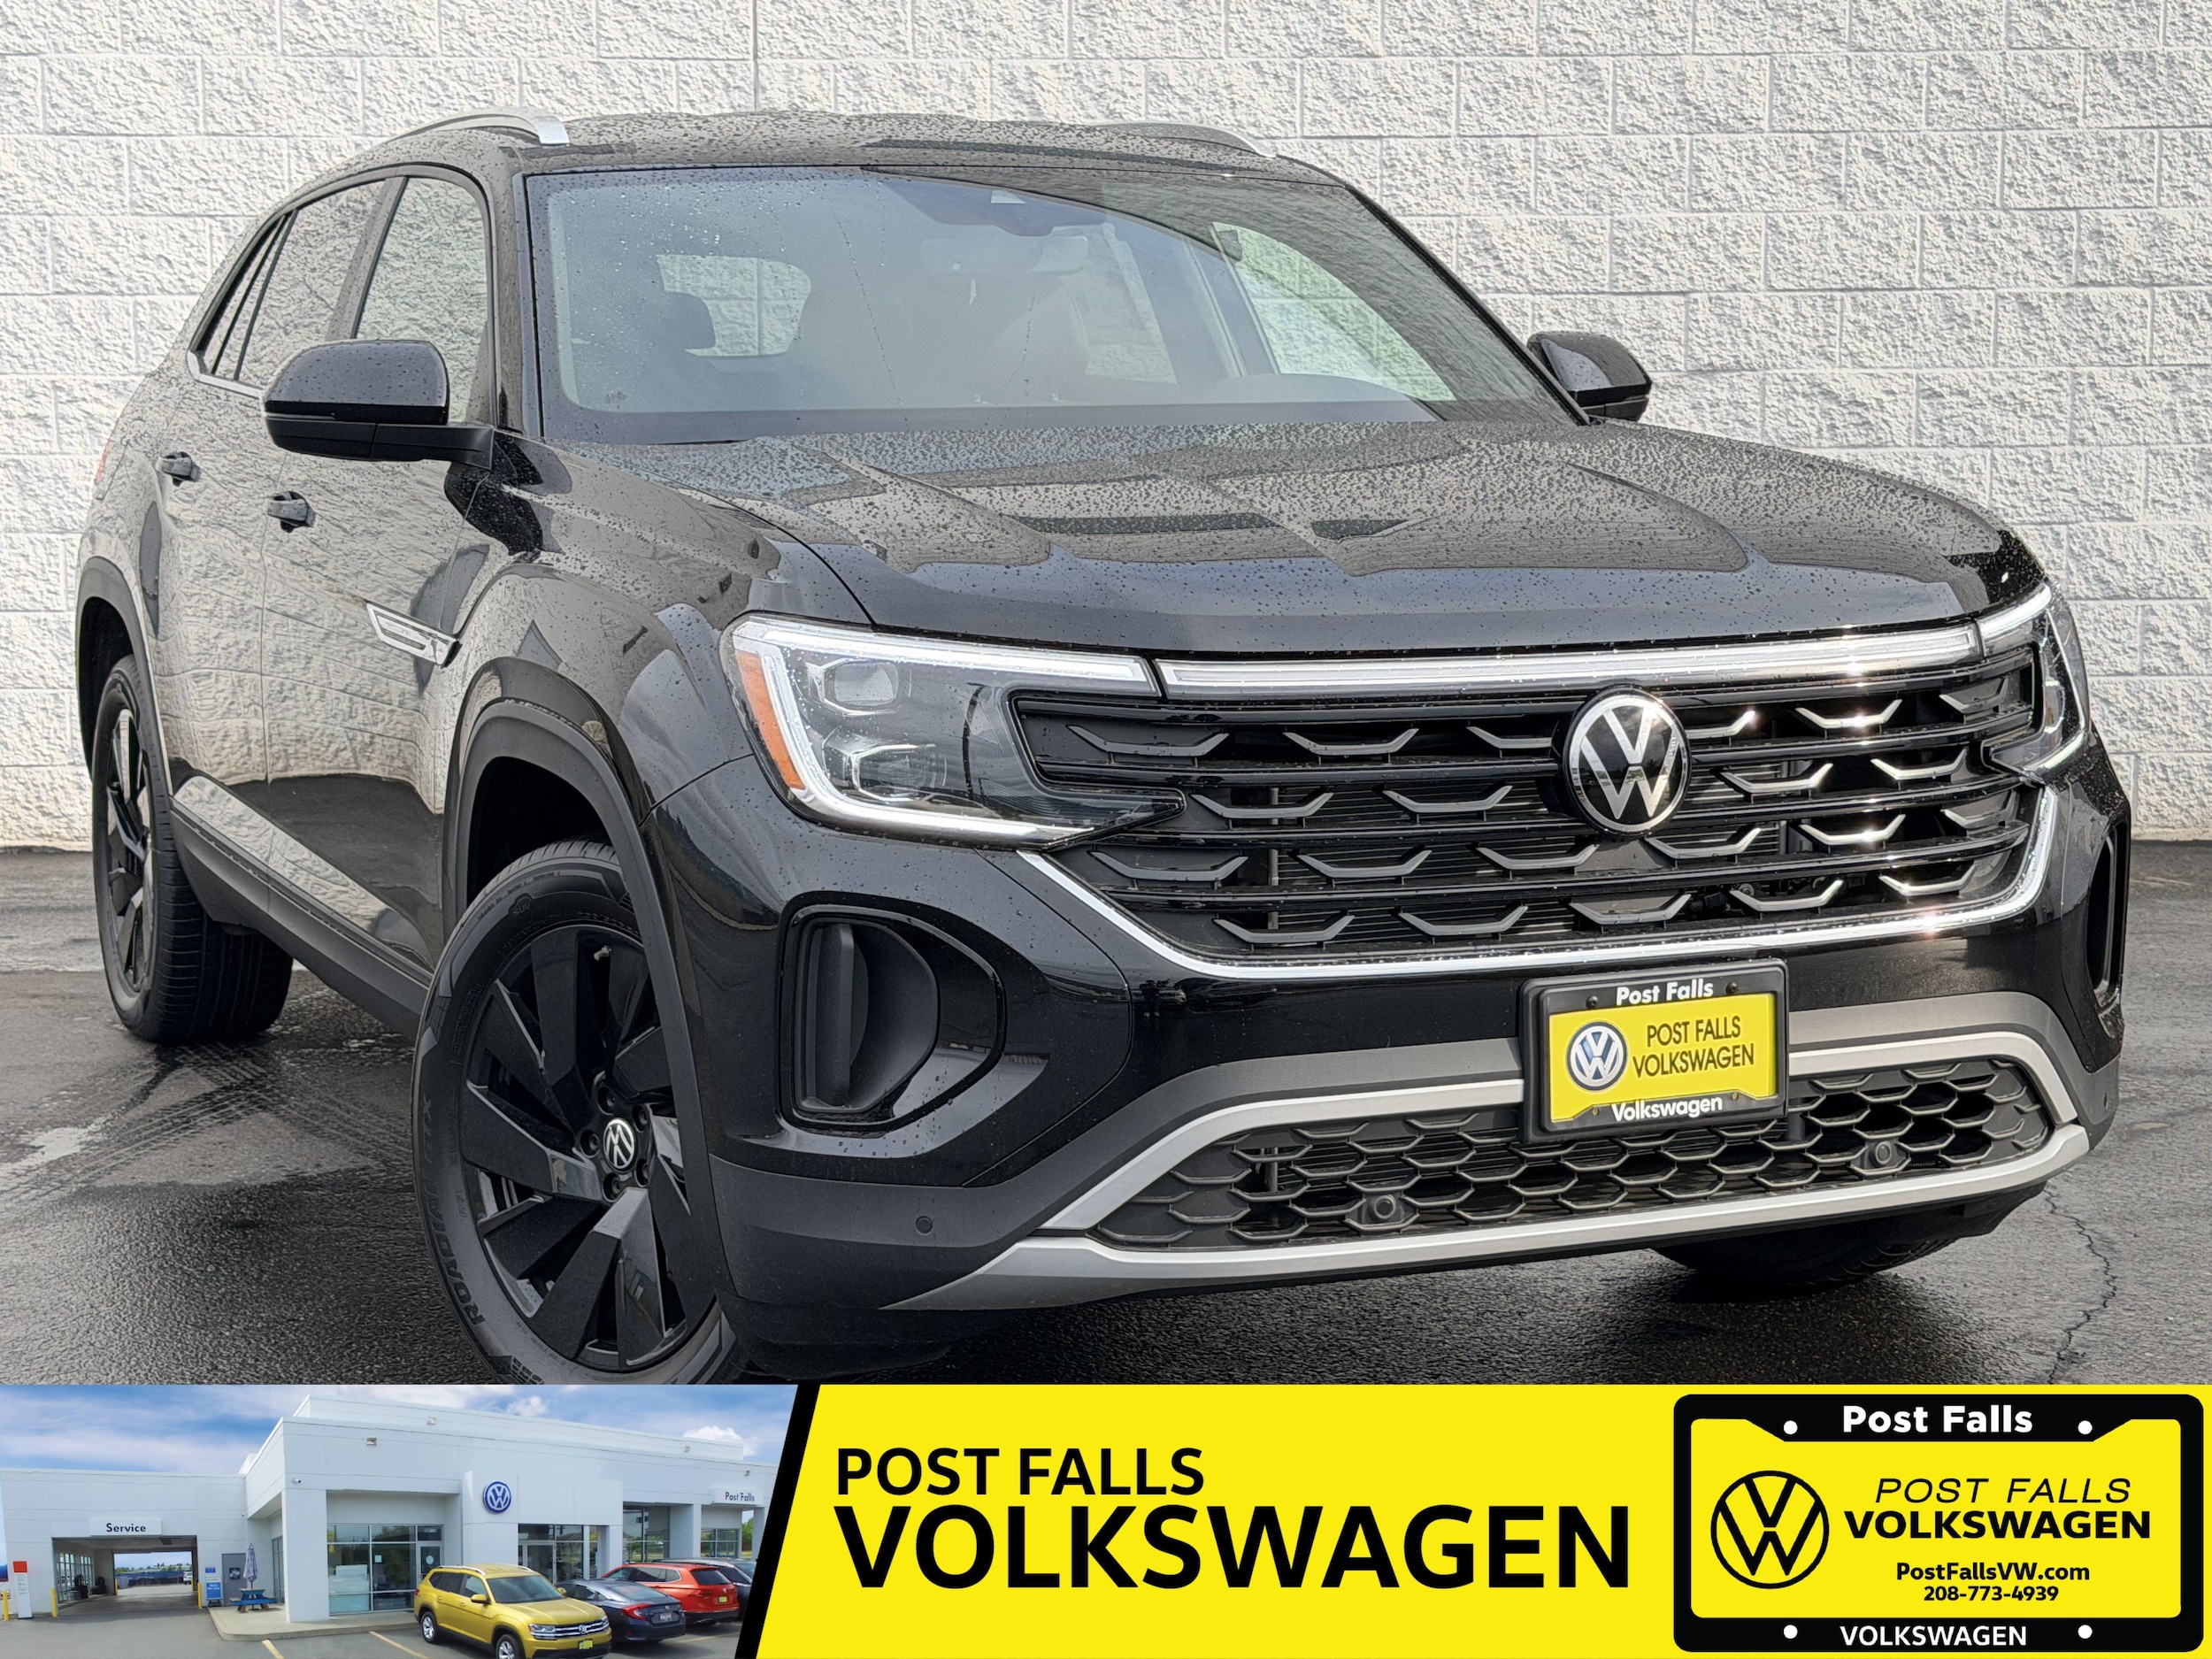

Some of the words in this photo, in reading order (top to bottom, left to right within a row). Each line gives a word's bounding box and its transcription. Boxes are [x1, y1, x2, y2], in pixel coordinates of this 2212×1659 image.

[1616, 984, 1660, 1006] Post
[1666, 978, 1714, 1001] Falls
[1647, 1020, 1690, 1048] POST
[1695, 1015, 1740, 1042] FALLS
[1632, 1043, 1754, 1078] VOLKSWAGEN
[1611, 1095, 1723, 1123] Volkswagen
[725, 1492, 739, 1501] Post
[740, 1493, 755, 1502] Falls
[106, 1523, 146, 1532] Service
